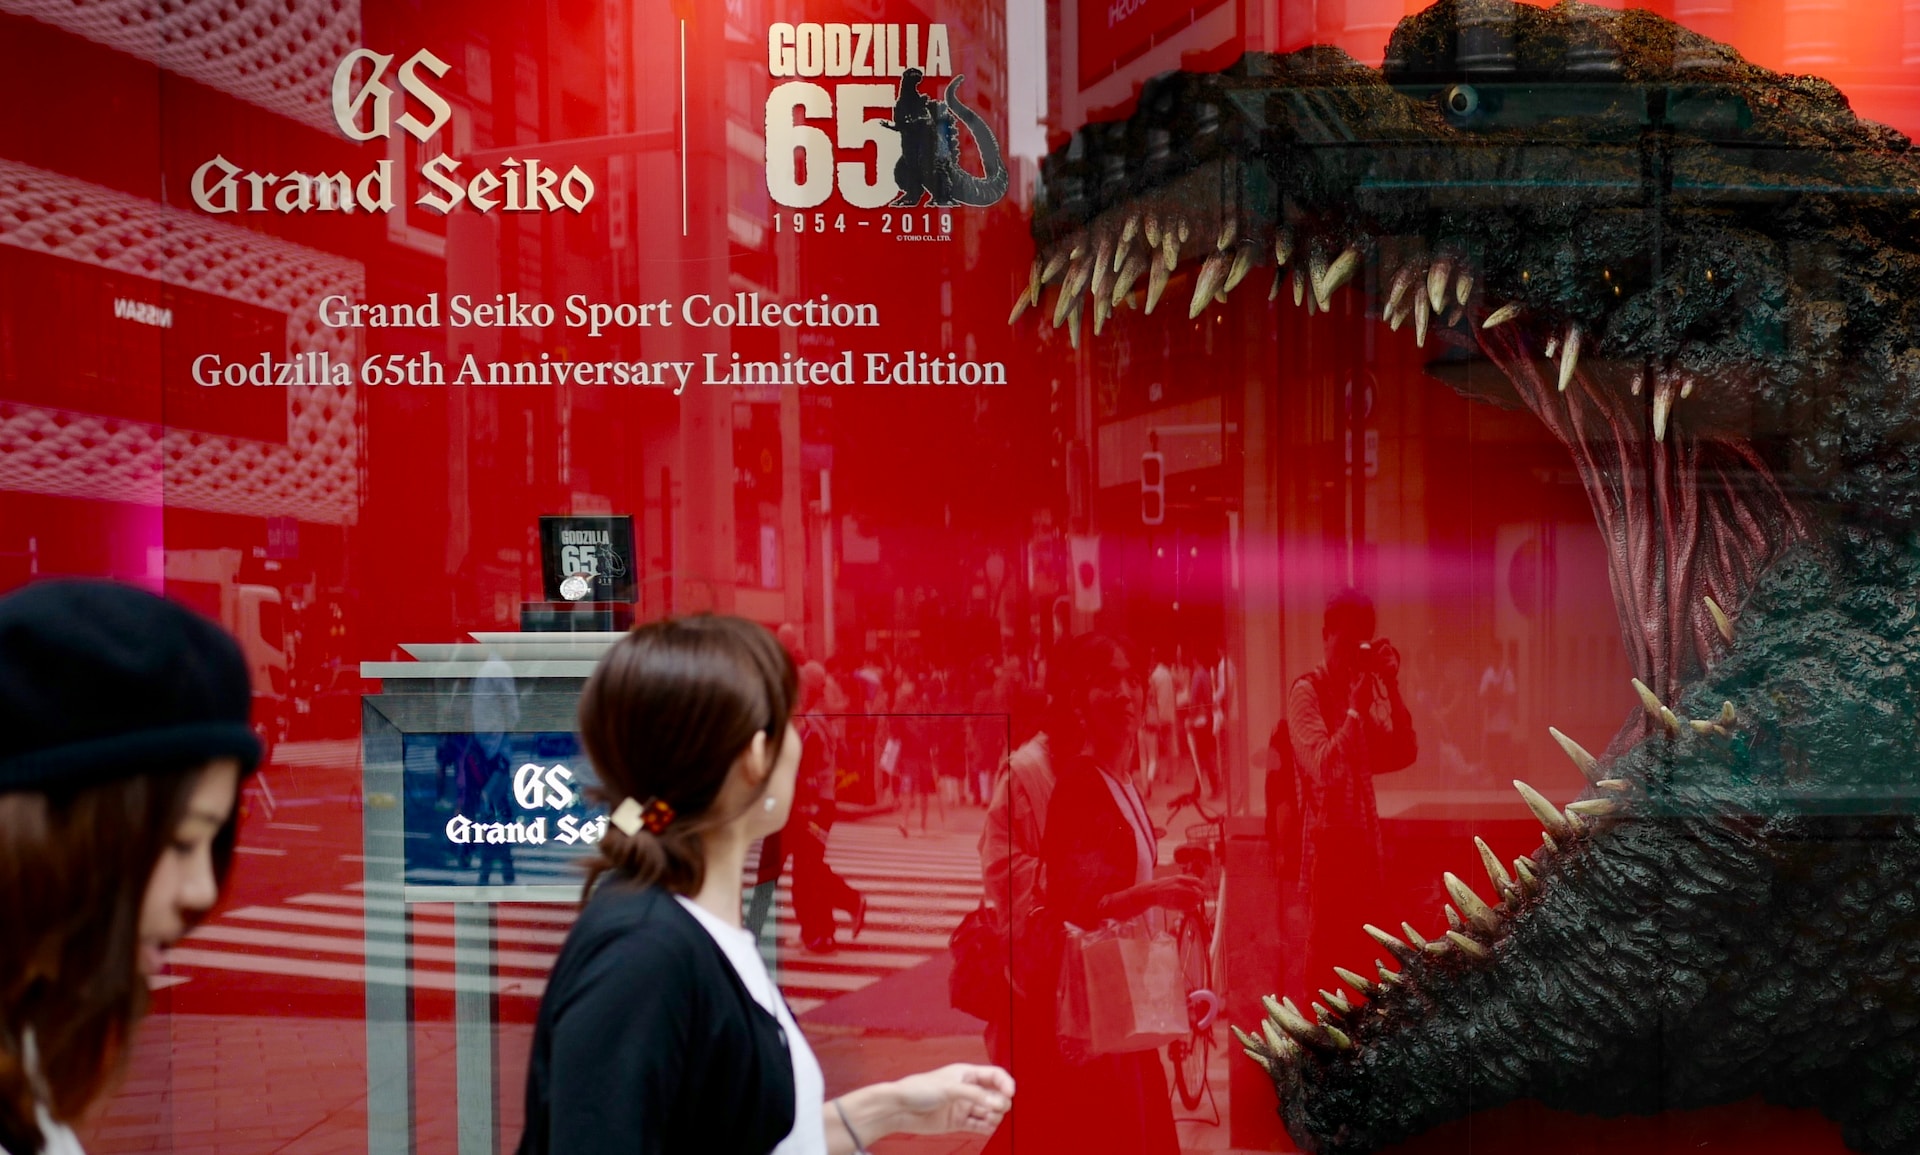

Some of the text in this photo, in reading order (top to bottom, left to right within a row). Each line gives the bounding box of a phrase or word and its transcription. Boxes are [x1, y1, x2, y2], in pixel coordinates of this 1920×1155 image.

[768, 22, 952, 77] GODZILLA
[331, 47, 452, 143] GS
[765, 80, 903, 209] 65
[190, 153, 396, 214] Grand
[415, 152, 595, 214] Seiko
[318, 291, 880, 338] Grand Seiko Sport Collection
[192, 350, 1007, 396] Godzilla 65th Anniversary Limited Edition
[561, 530, 609, 545] GODZILLA
[561, 545, 599, 577] 65
[513, 762, 573, 811] GS
[445, 812, 610, 845] Grand Sei
